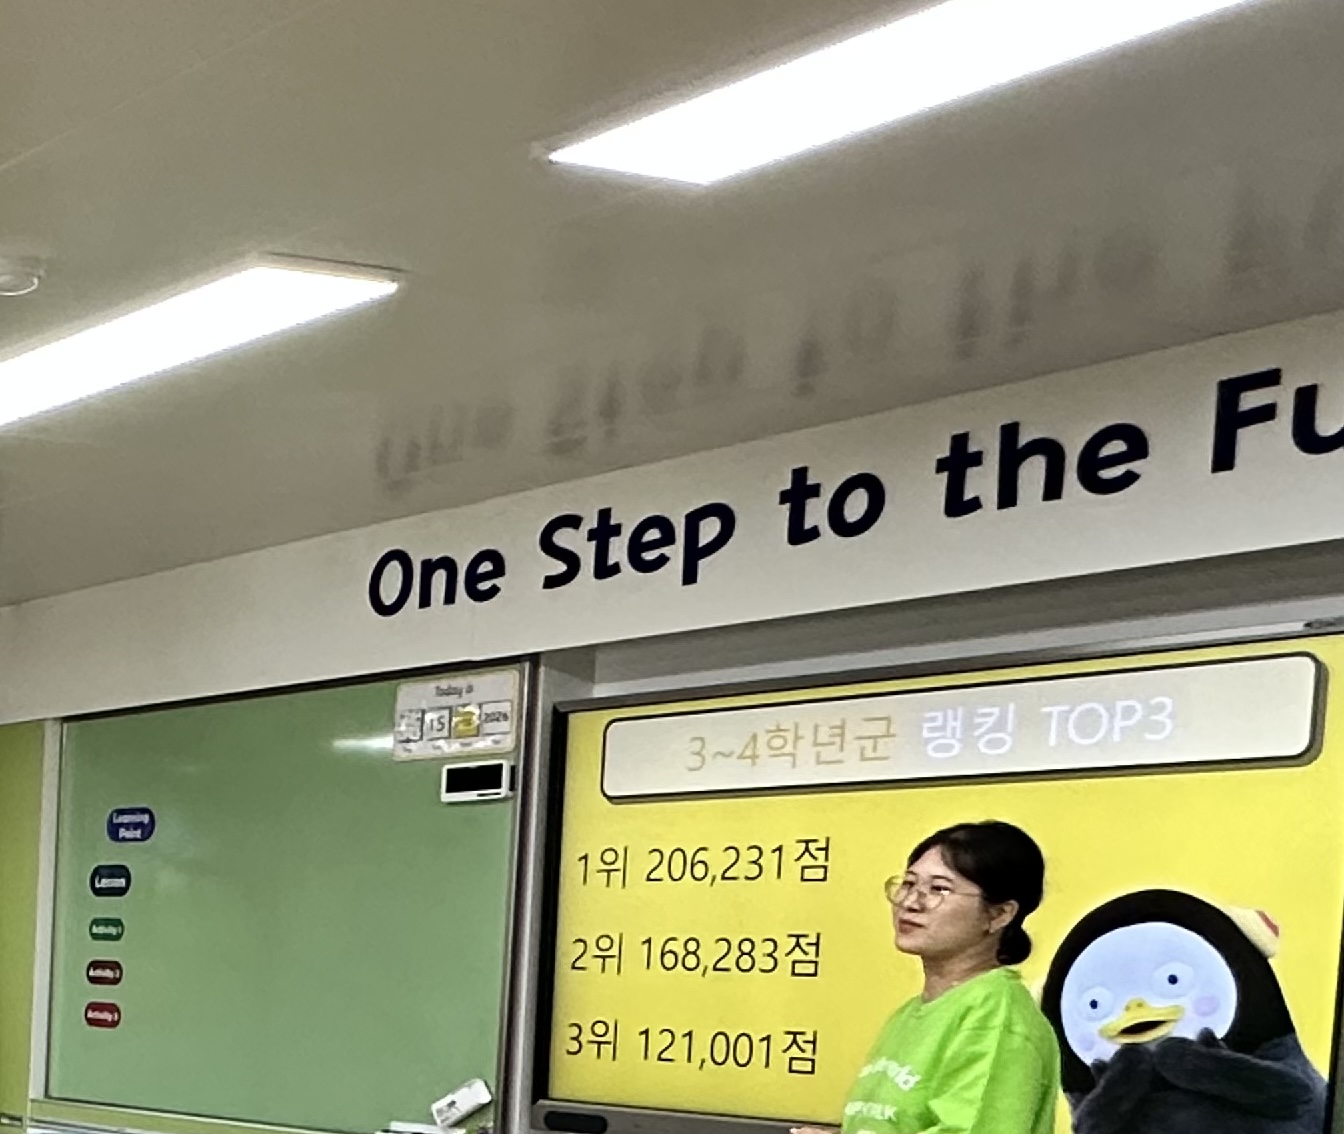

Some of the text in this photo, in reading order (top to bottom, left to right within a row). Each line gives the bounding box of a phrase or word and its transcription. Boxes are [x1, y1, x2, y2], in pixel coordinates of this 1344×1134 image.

[368, 367, 1344, 618] One Step to the Fu
[686, 696, 1174, 772] 3~4학년군 랭킹 TOP3
[576, 835, 831, 890] 1위 206,231점
[570, 931, 822, 978] 2위 168,283점
[565, 1018, 619, 1062] 3위
[638, 1027, 819, 1076] 121,001점
